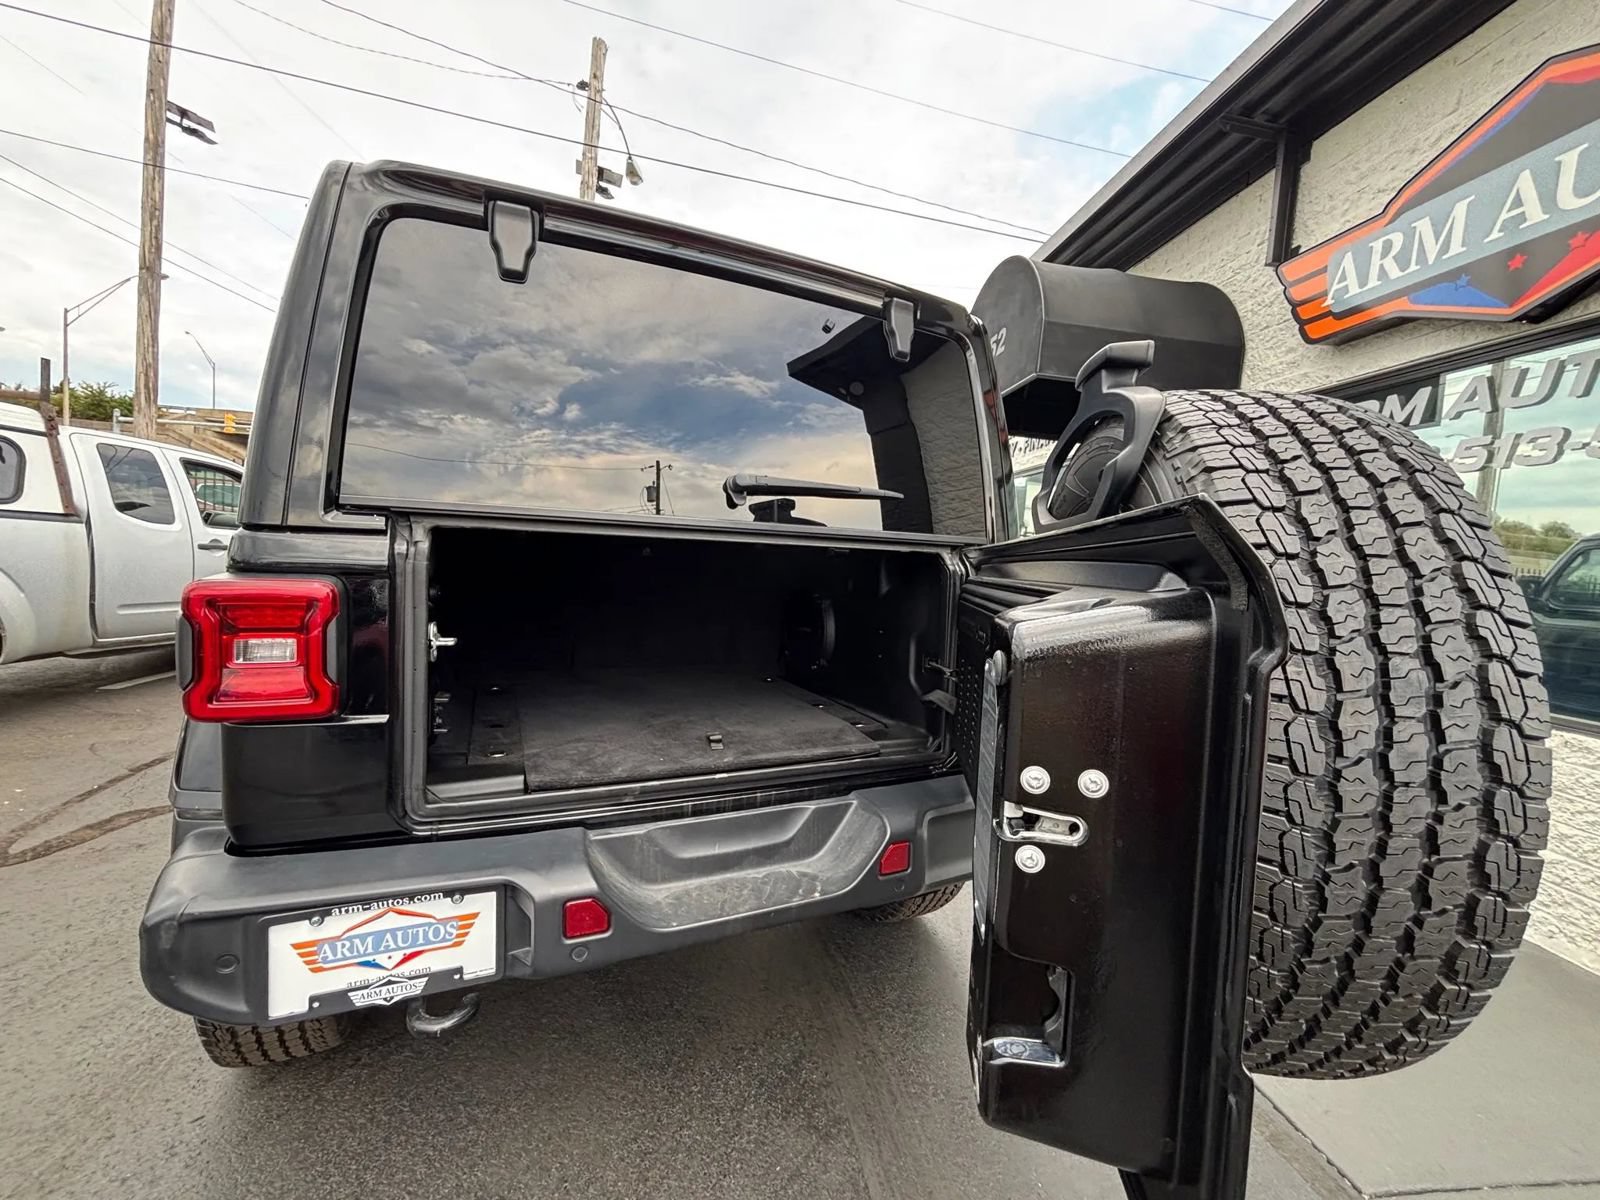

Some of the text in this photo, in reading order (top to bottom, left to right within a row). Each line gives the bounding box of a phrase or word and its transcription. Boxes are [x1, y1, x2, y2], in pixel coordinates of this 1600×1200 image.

[1321, 194, 1475, 307] ARM
[331, 892, 444, 916] arm-autos.com
[318, 920, 459, 962] ARM AUTOS
[359, 981, 418, 1001] ARM AUTOS
